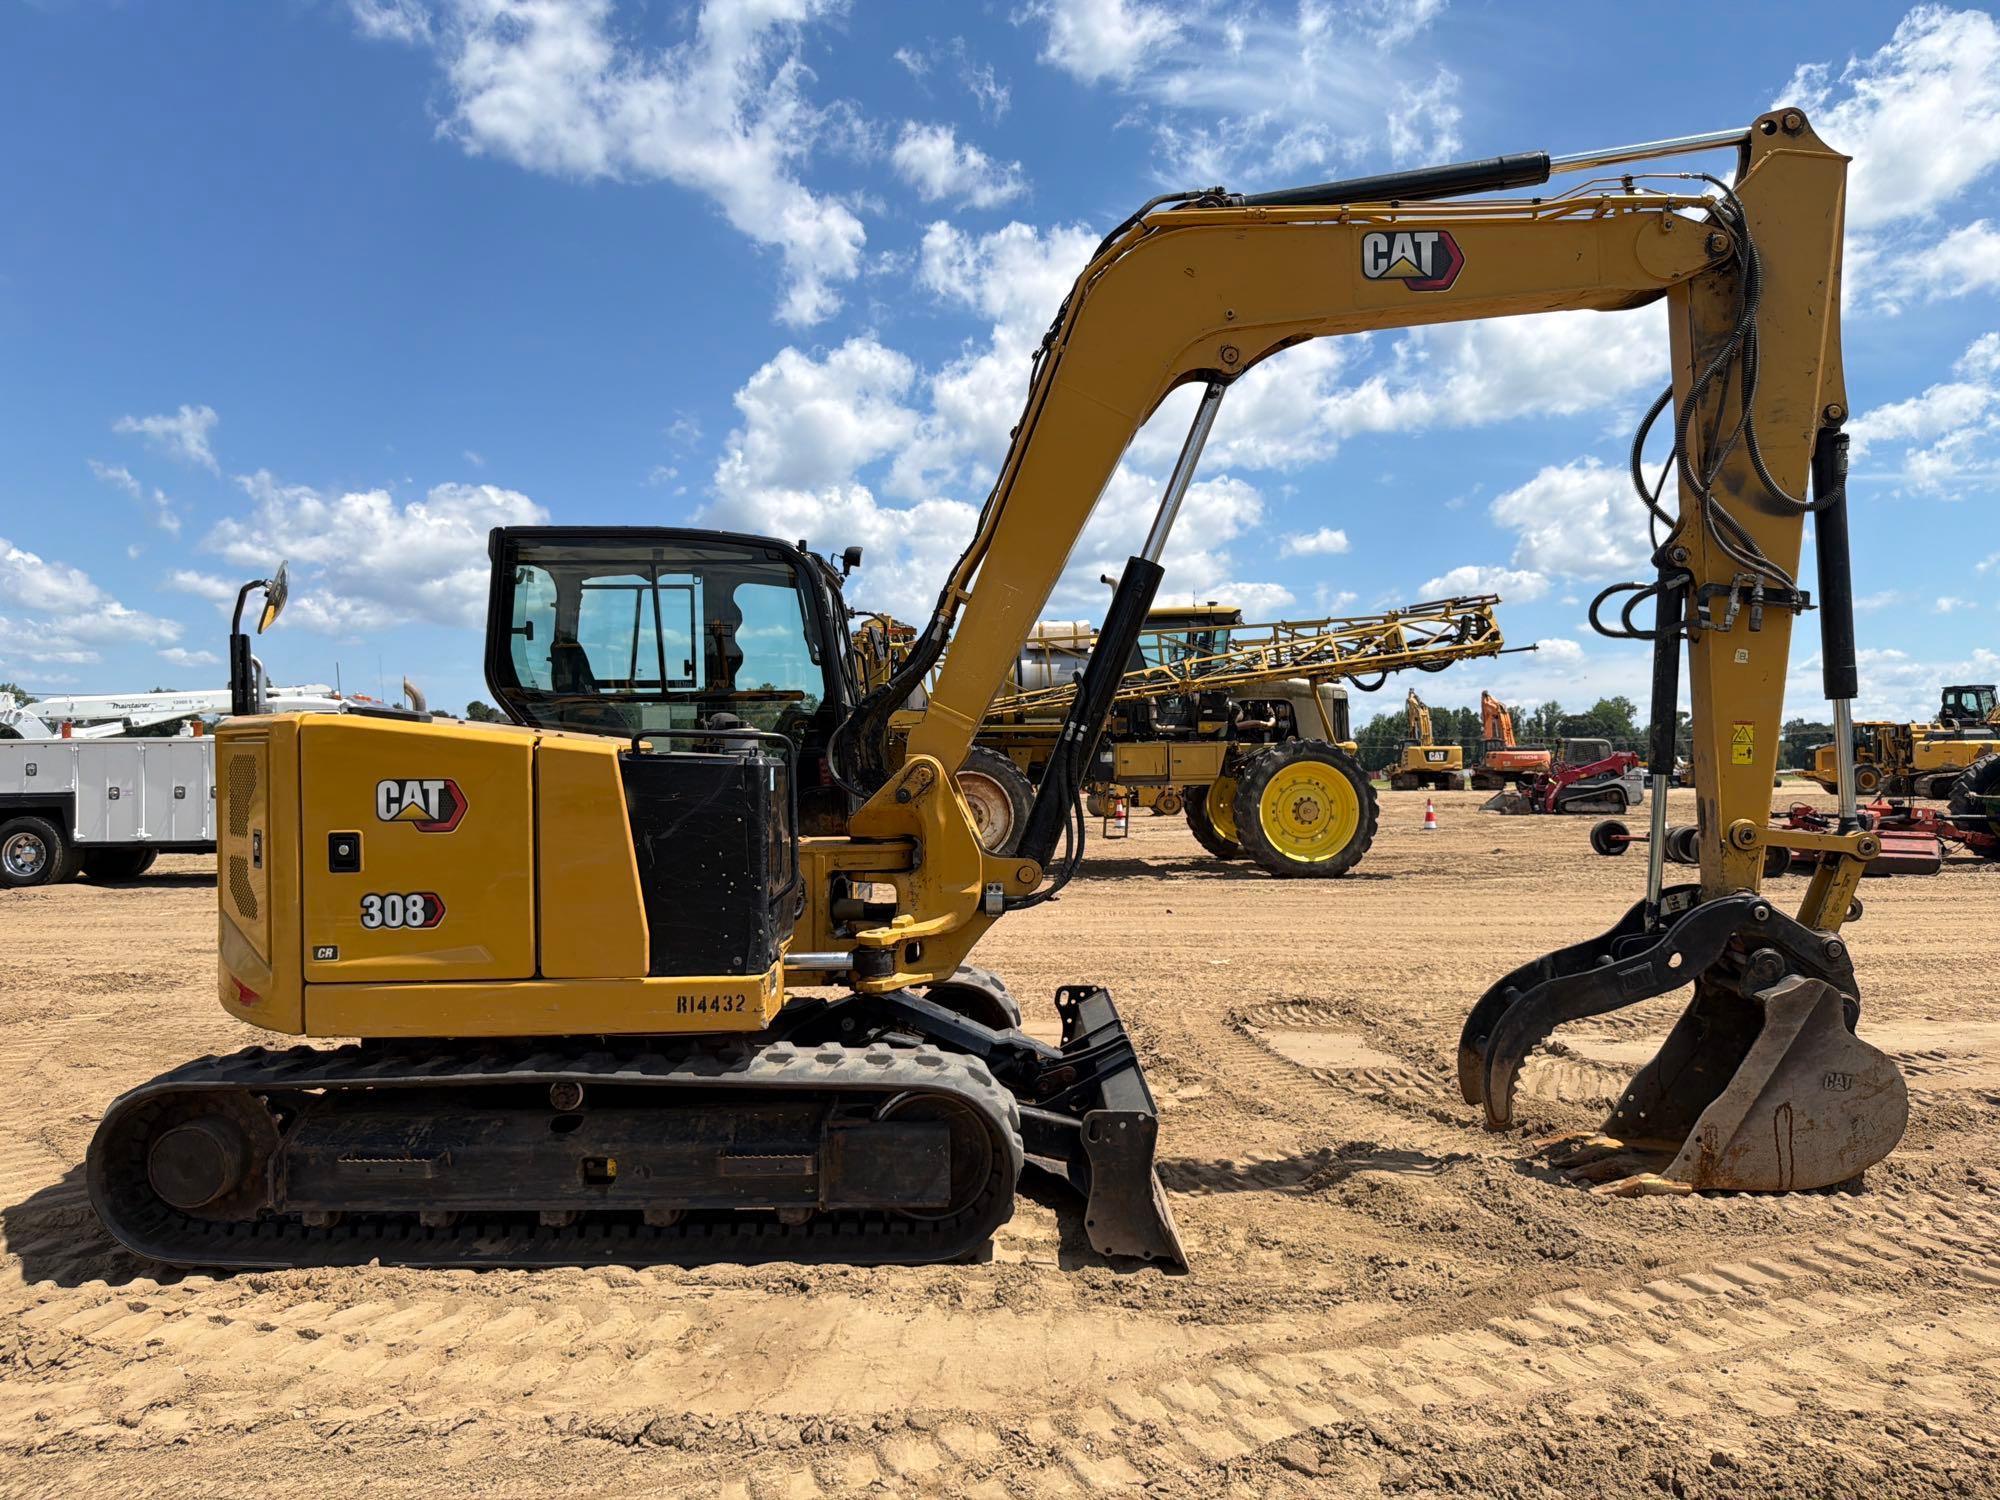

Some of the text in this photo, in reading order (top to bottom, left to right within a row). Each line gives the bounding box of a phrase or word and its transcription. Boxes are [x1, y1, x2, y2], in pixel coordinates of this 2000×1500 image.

[1364, 231, 1438, 278] CAT
[1428, 752, 1444, 760] CAT
[378, 781, 444, 820] CAT
[363, 894, 424, 927] 308
[317, 948, 333, 958] CR
[677, 994, 746, 1013] R14432
[1824, 1073, 1852, 1090] CAT
